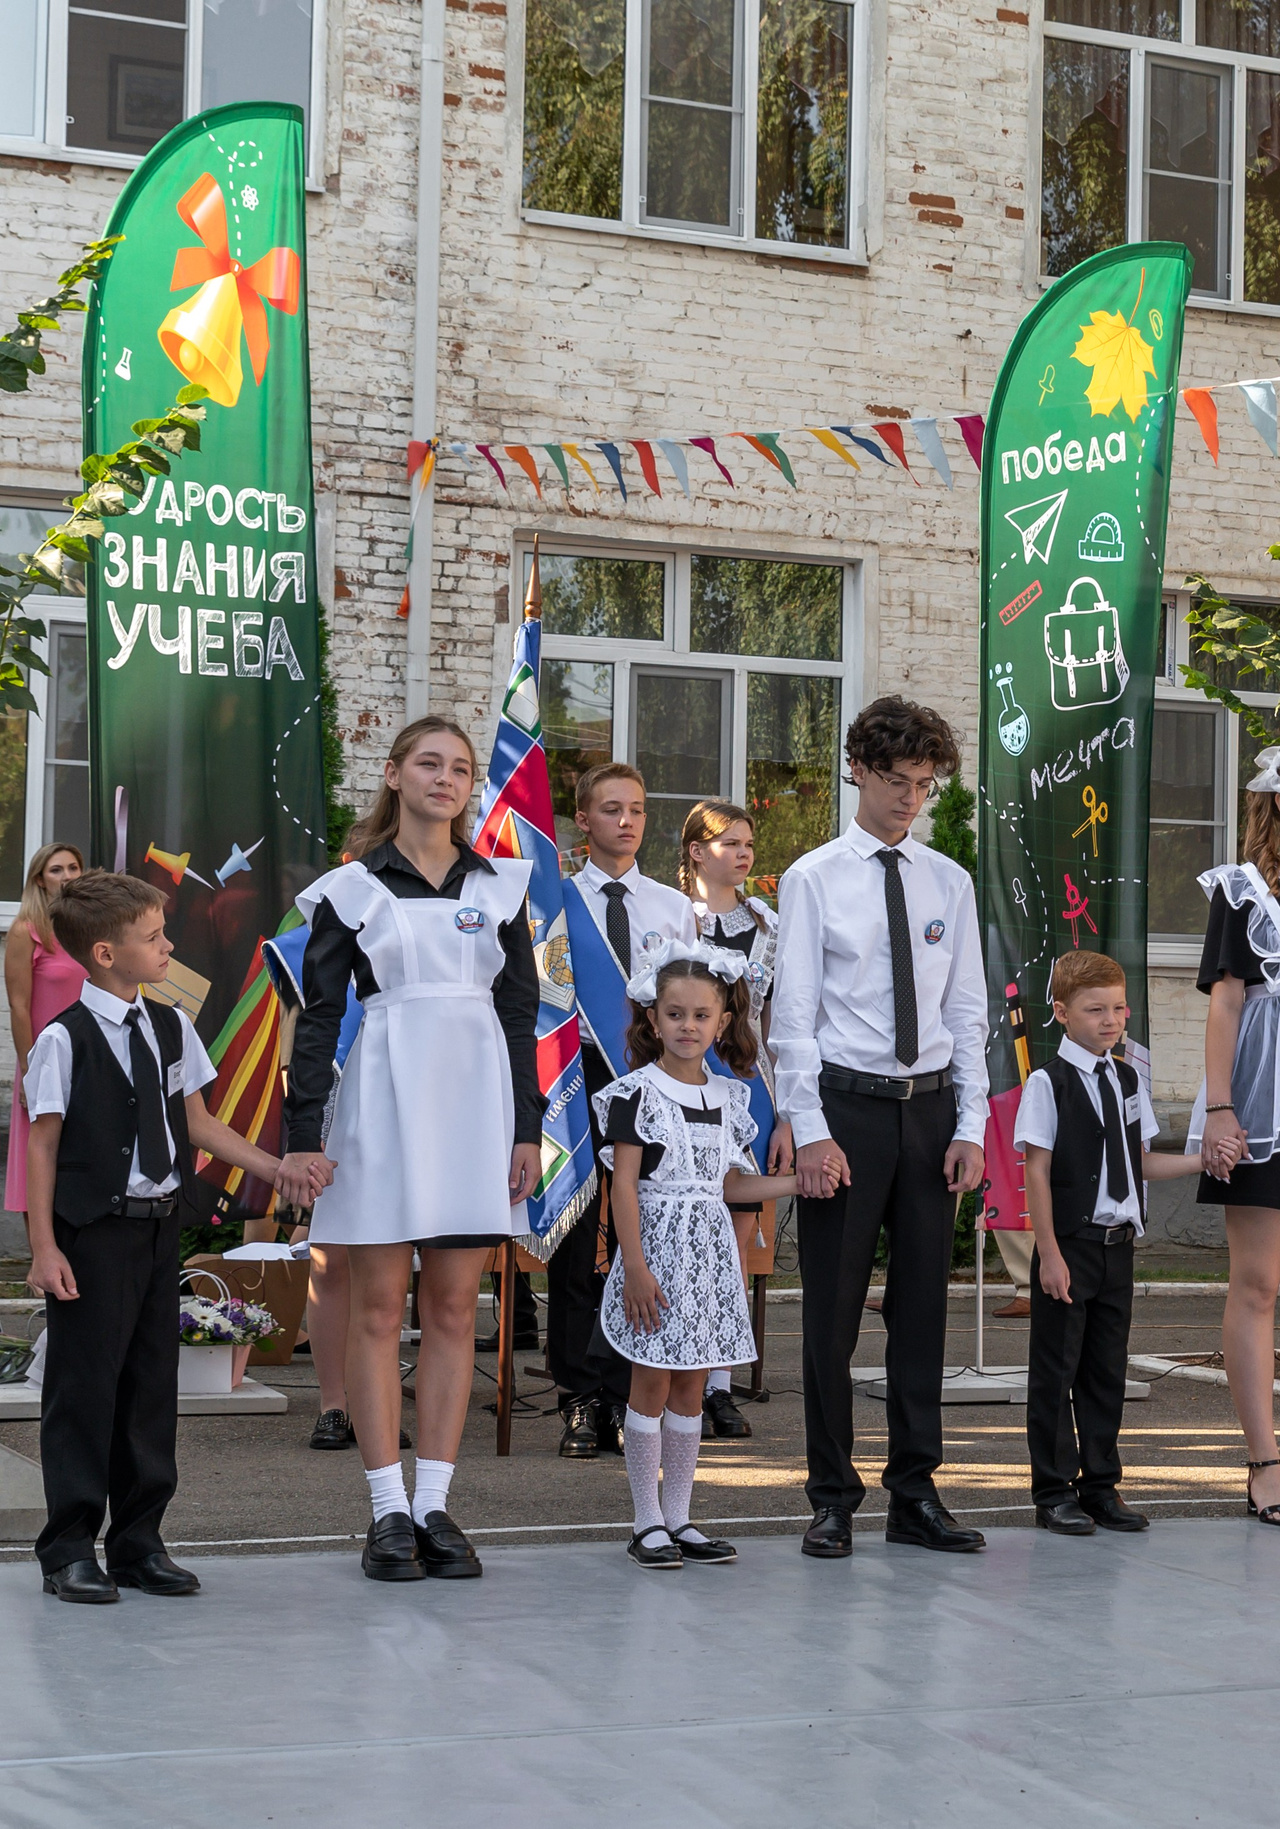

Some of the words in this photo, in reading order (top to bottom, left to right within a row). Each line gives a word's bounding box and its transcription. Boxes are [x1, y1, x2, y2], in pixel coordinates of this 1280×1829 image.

[1001, 430, 1127, 484] победа
[122, 476, 306, 533] УДРОСТЬ
[104, 532, 306, 603] ЗНАНИЯ
[106, 600, 305, 681] УЧЕБА
[545, 1074, 583, 1123] ИМЕНИ
